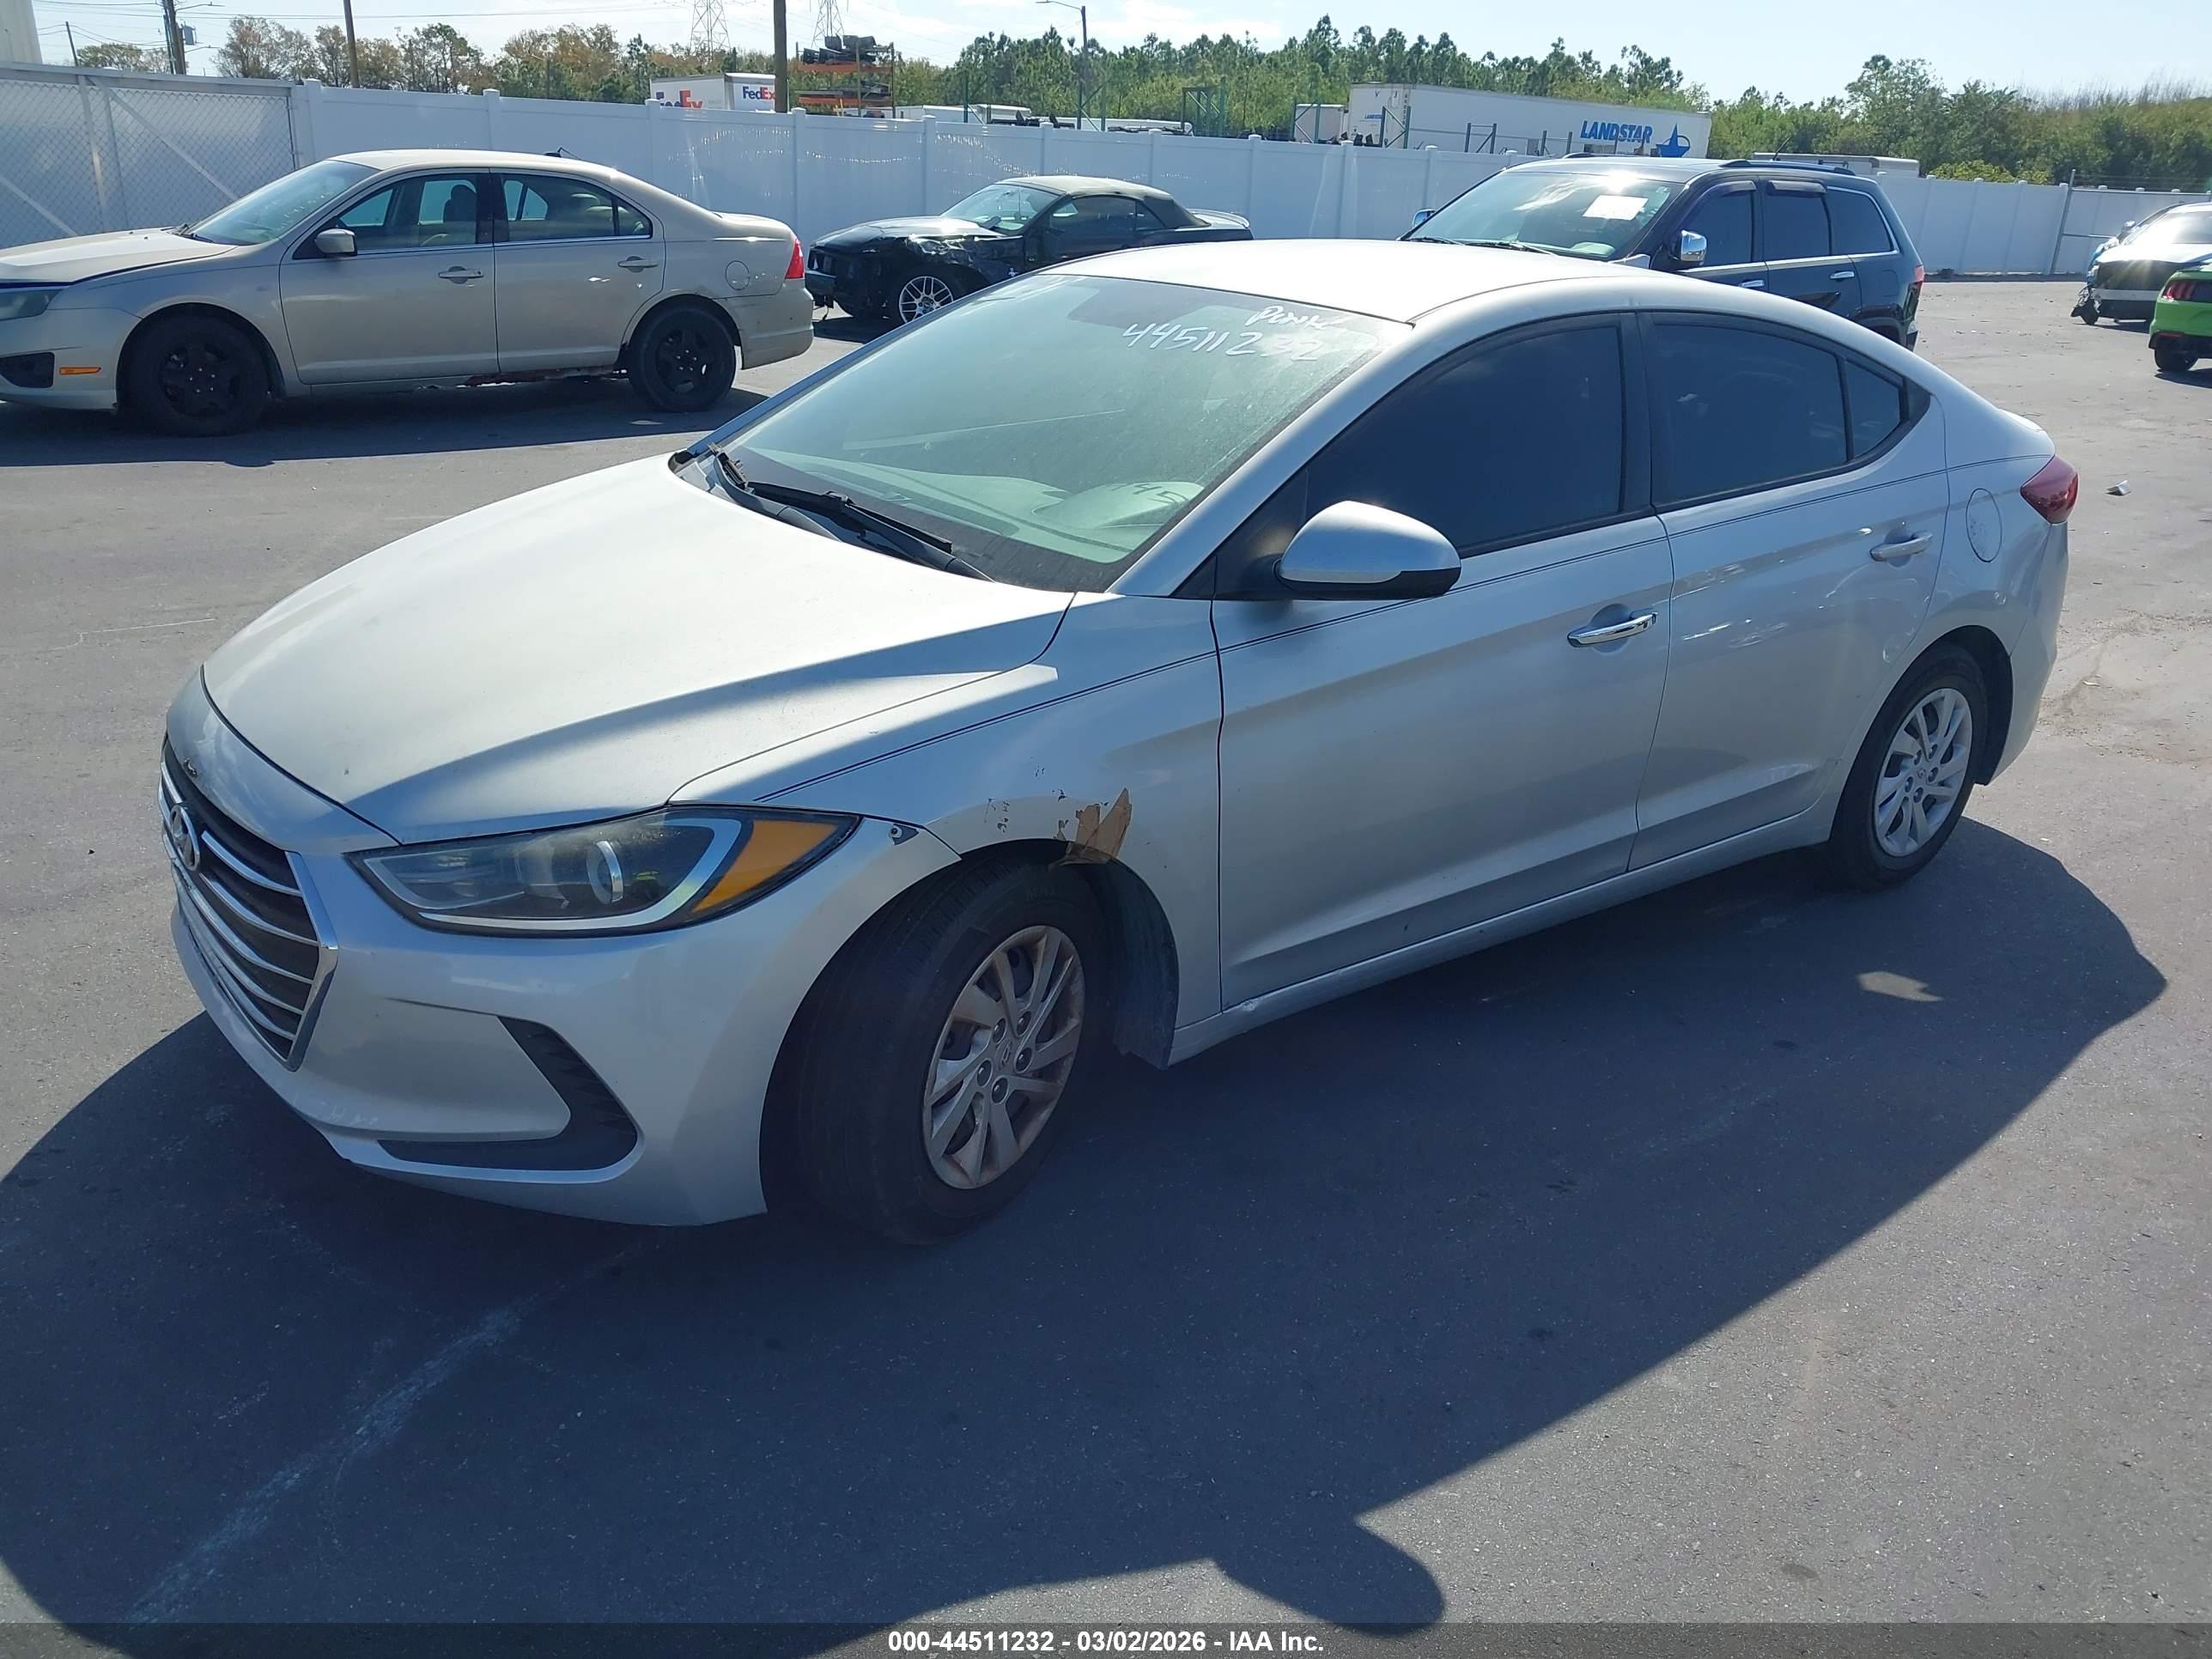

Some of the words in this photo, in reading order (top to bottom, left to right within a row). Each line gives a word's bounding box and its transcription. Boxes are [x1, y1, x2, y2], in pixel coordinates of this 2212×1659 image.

[742, 86, 775, 100] FedEx
[1580, 120, 1653, 143] LANDSTAR
[1122, 322, 1324, 362] 44511232
